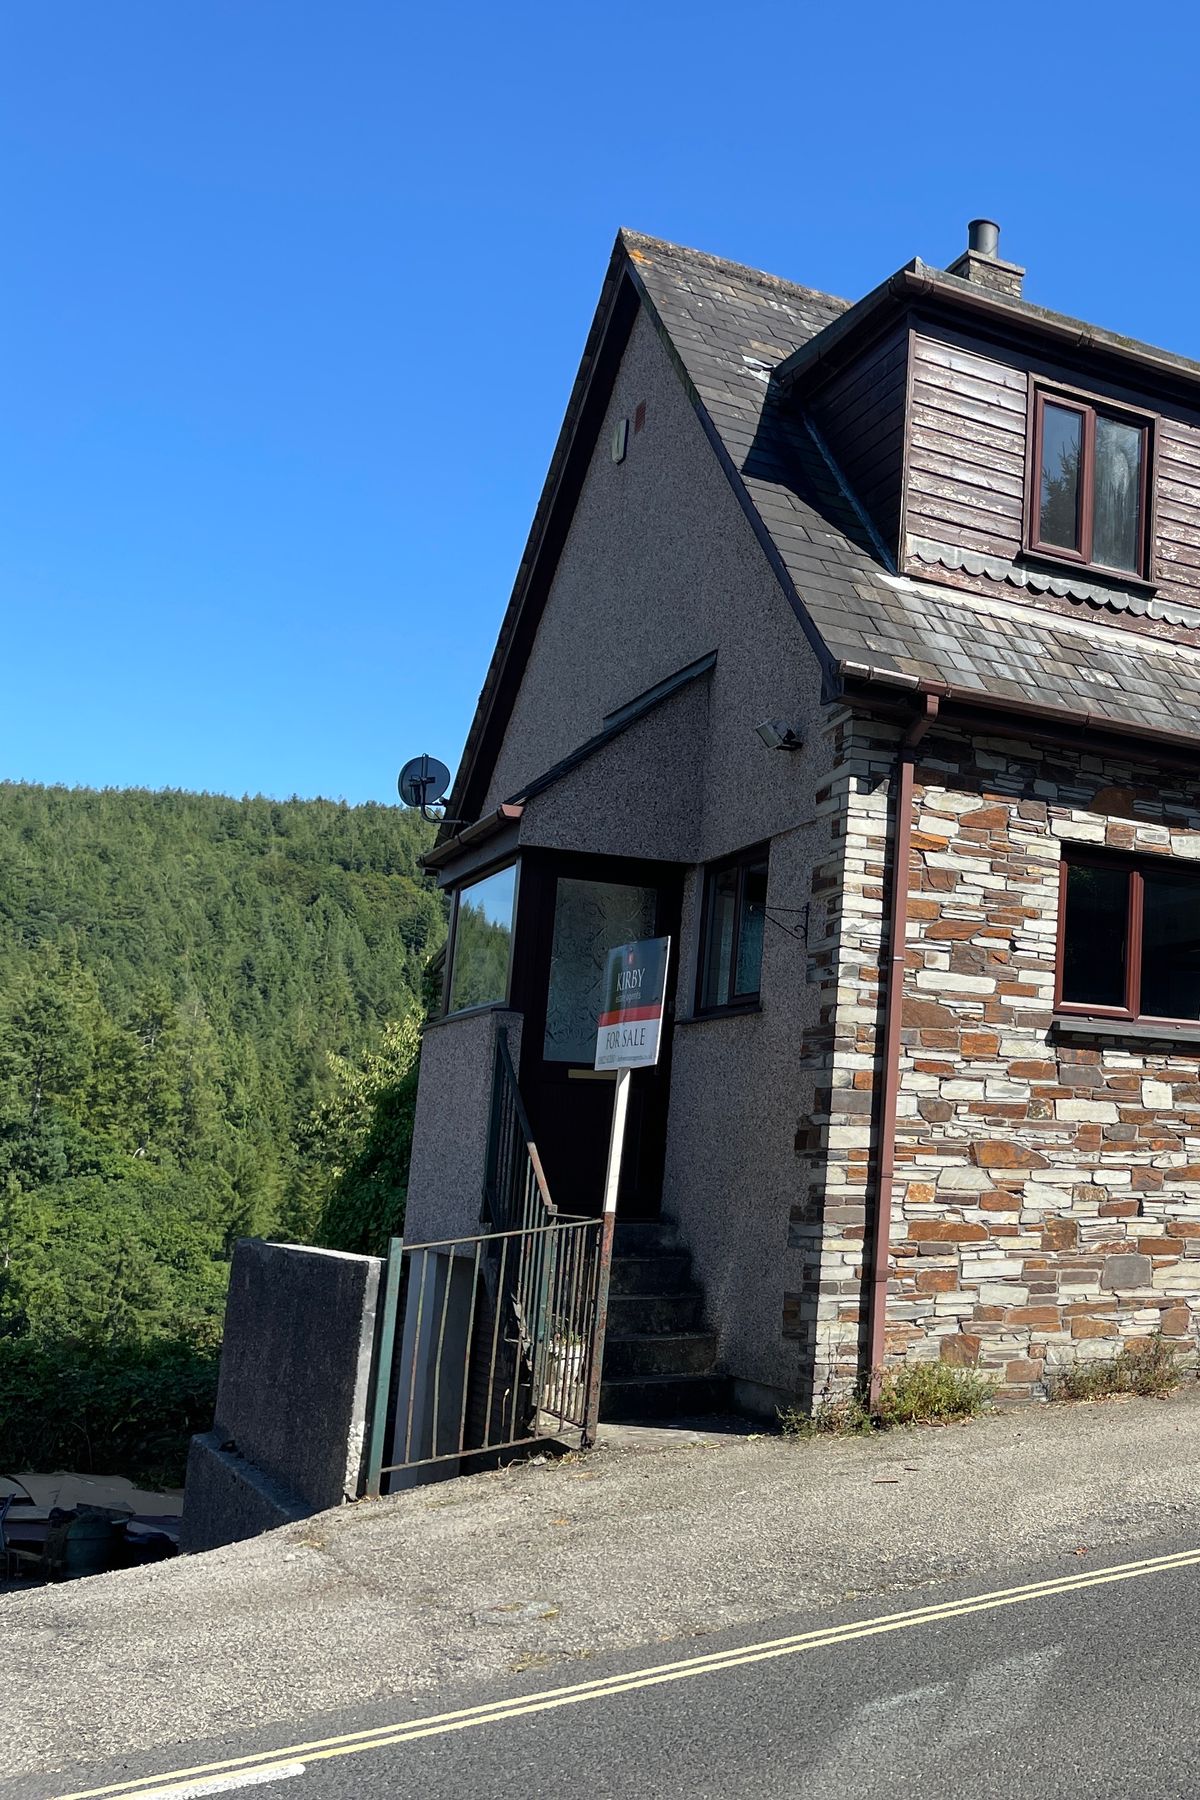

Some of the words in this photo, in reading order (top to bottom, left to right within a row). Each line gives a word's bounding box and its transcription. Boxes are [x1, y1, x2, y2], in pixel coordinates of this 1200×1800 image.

[616, 968, 645, 992] KIRBY
[605, 1033, 621, 1051] FOR
[622, 1028, 647, 1048] SALE
